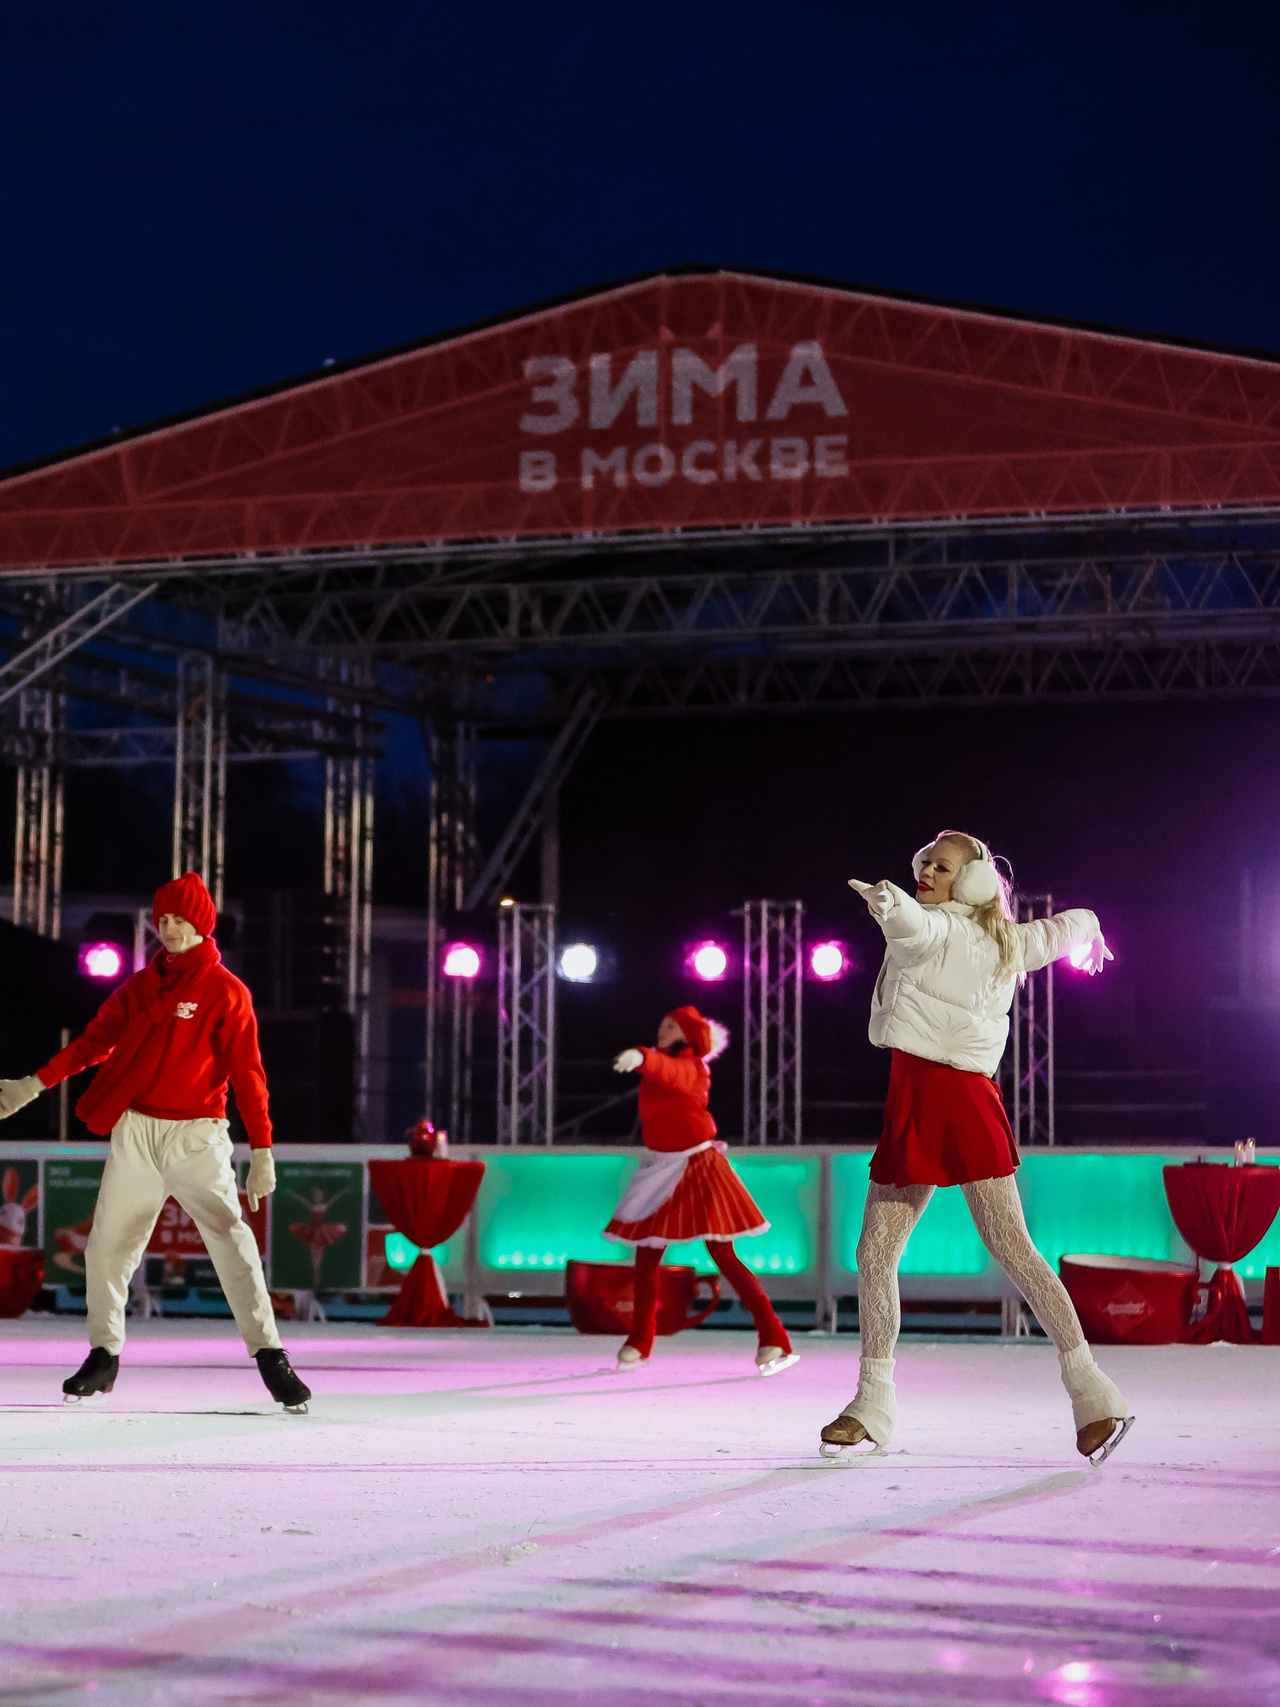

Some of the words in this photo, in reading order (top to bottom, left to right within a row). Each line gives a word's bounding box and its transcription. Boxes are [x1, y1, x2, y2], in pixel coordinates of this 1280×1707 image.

[520, 341, 848, 435] ЗИМА
[520, 449, 556, 492] В
[581, 434, 848, 490] МОСКВЕ
